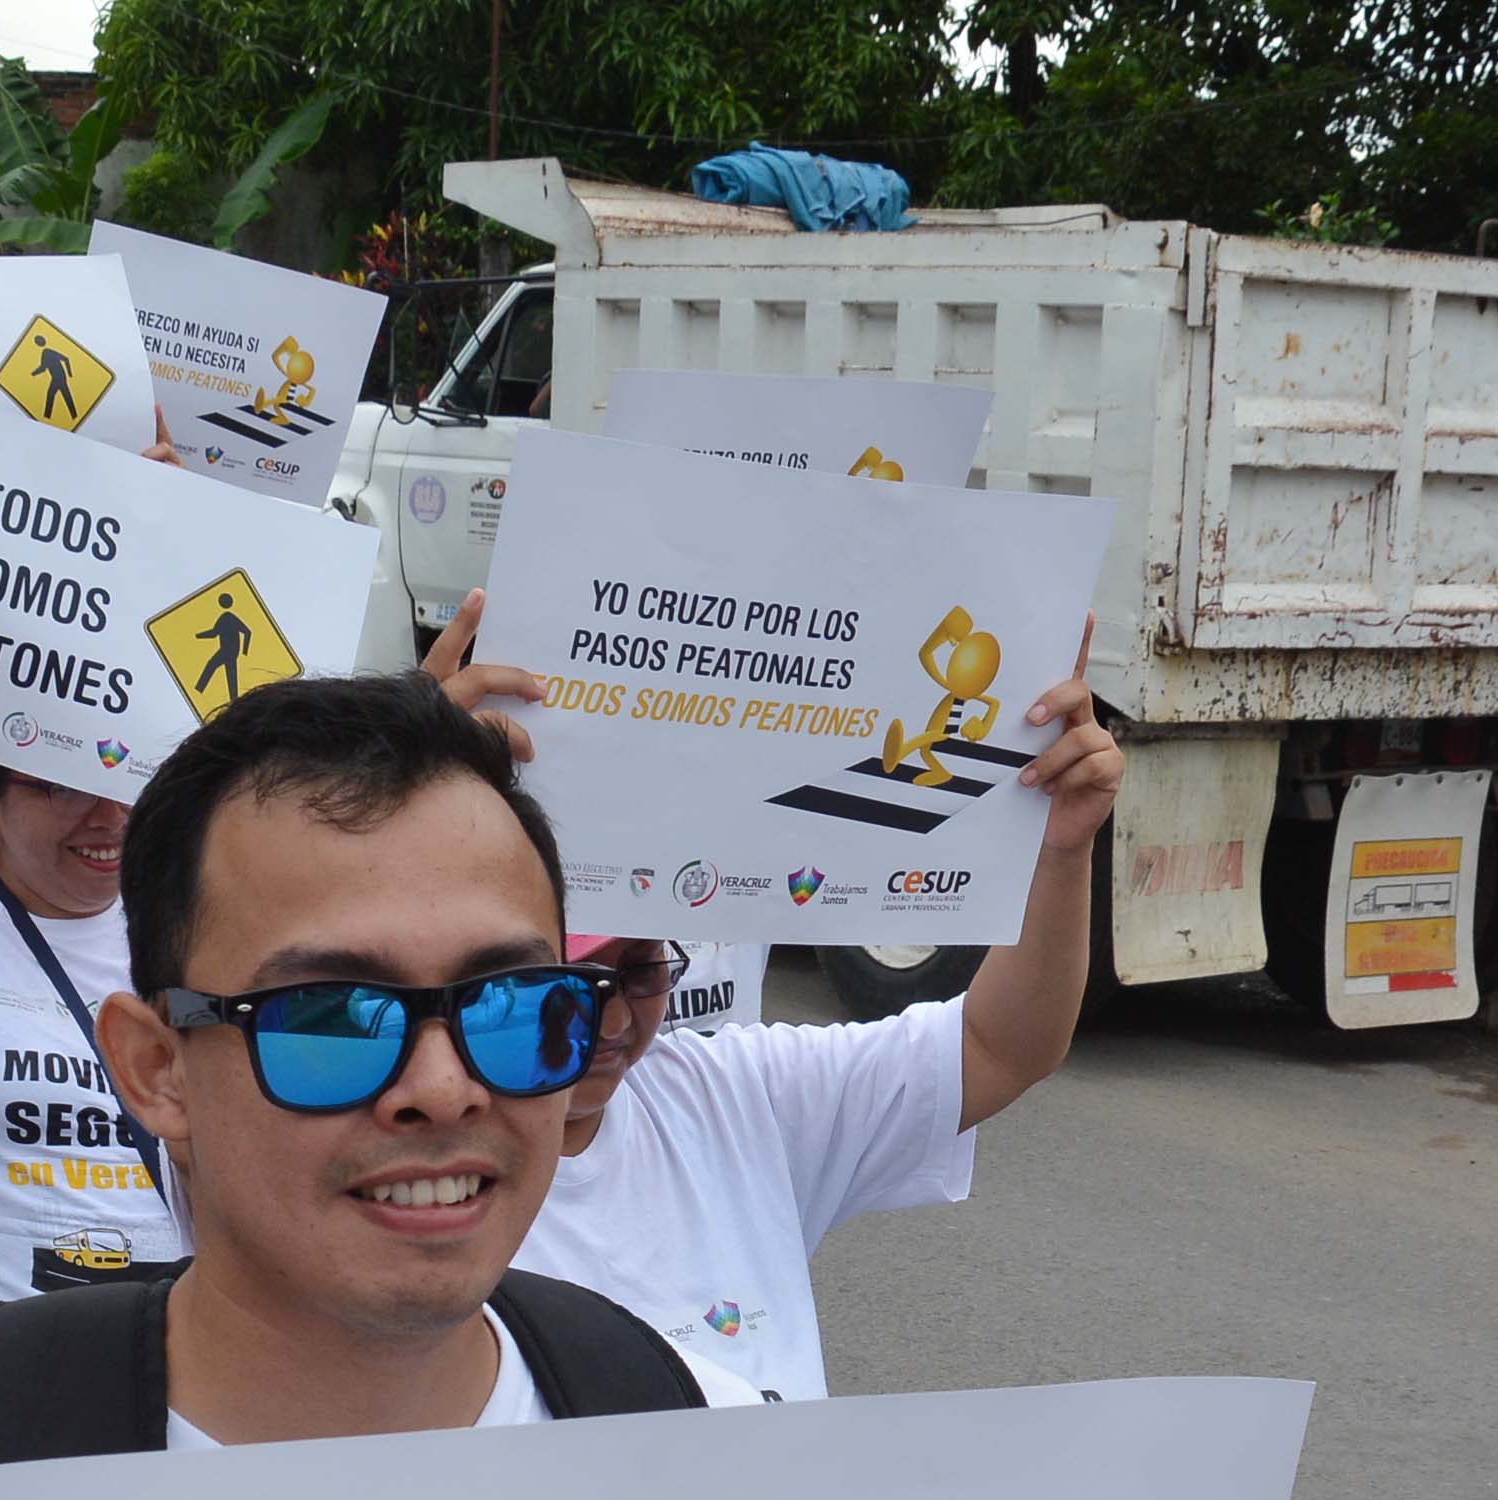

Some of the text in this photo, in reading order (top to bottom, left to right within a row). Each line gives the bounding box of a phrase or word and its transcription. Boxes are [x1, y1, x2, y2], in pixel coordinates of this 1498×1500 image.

[134, 308, 260, 353] REZCO MI AYUDA SI
[165, 341, 182, 359] LO
[186, 346, 245, 374] NECESITA
[150, 361, 252, 397] OMOS PEATONES
[593, 579, 859, 642] YO CRUZO POR LOS
[570, 629, 855, 690] PASOS PEATONALES
[631, 687, 736, 727] SOMOS
[739, 699, 879, 738] PEATONES
[39, 728, 83, 749] VERACRUZ
[720, 875, 772, 889] VERACRUZ
[822, 883, 869, 895] Trabajamos
[887, 870, 971, 894] CeSUP
[821, 896, 848, 905] Juntos
[663, 981, 734, 1023] LIDAD
[5, 1101, 137, 1149] SEGU
[7, 1157, 154, 1190] en Vera
